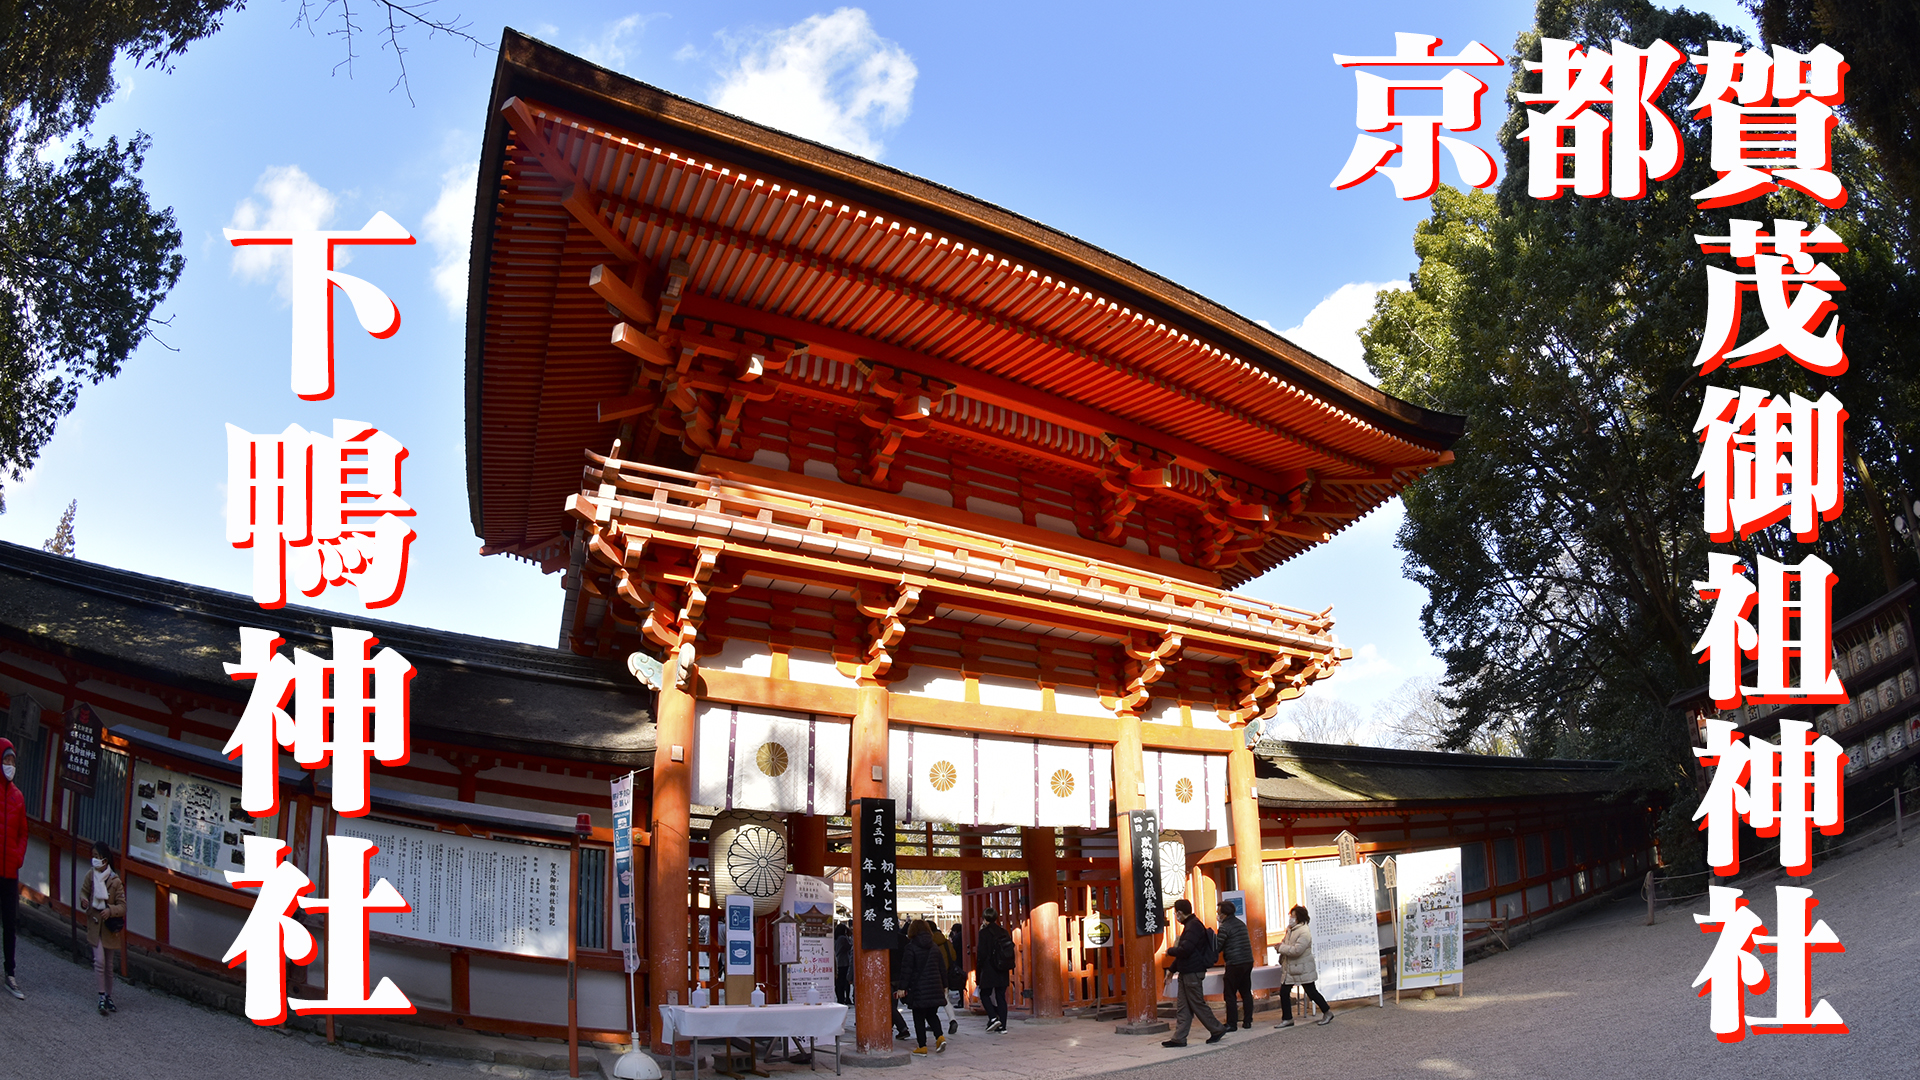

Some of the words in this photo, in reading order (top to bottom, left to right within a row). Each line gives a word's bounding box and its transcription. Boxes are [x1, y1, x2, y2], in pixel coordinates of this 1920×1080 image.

[70, 730, 94, 743] 世界文化遺産
[64, 741, 97, 760] 賀茂御祖神社
[69, 754, 90, 767] 東西本殿
[873, 808, 885, 846] 一月五日
[1133, 816, 1143, 832] 四日
[1145, 816, 1154, 833] 一月
[549, 862, 557, 926] 賀茂御祖神社由緒記
[862, 858, 877, 922] 年賀祭
[880, 859, 895, 932] 初えと祭
